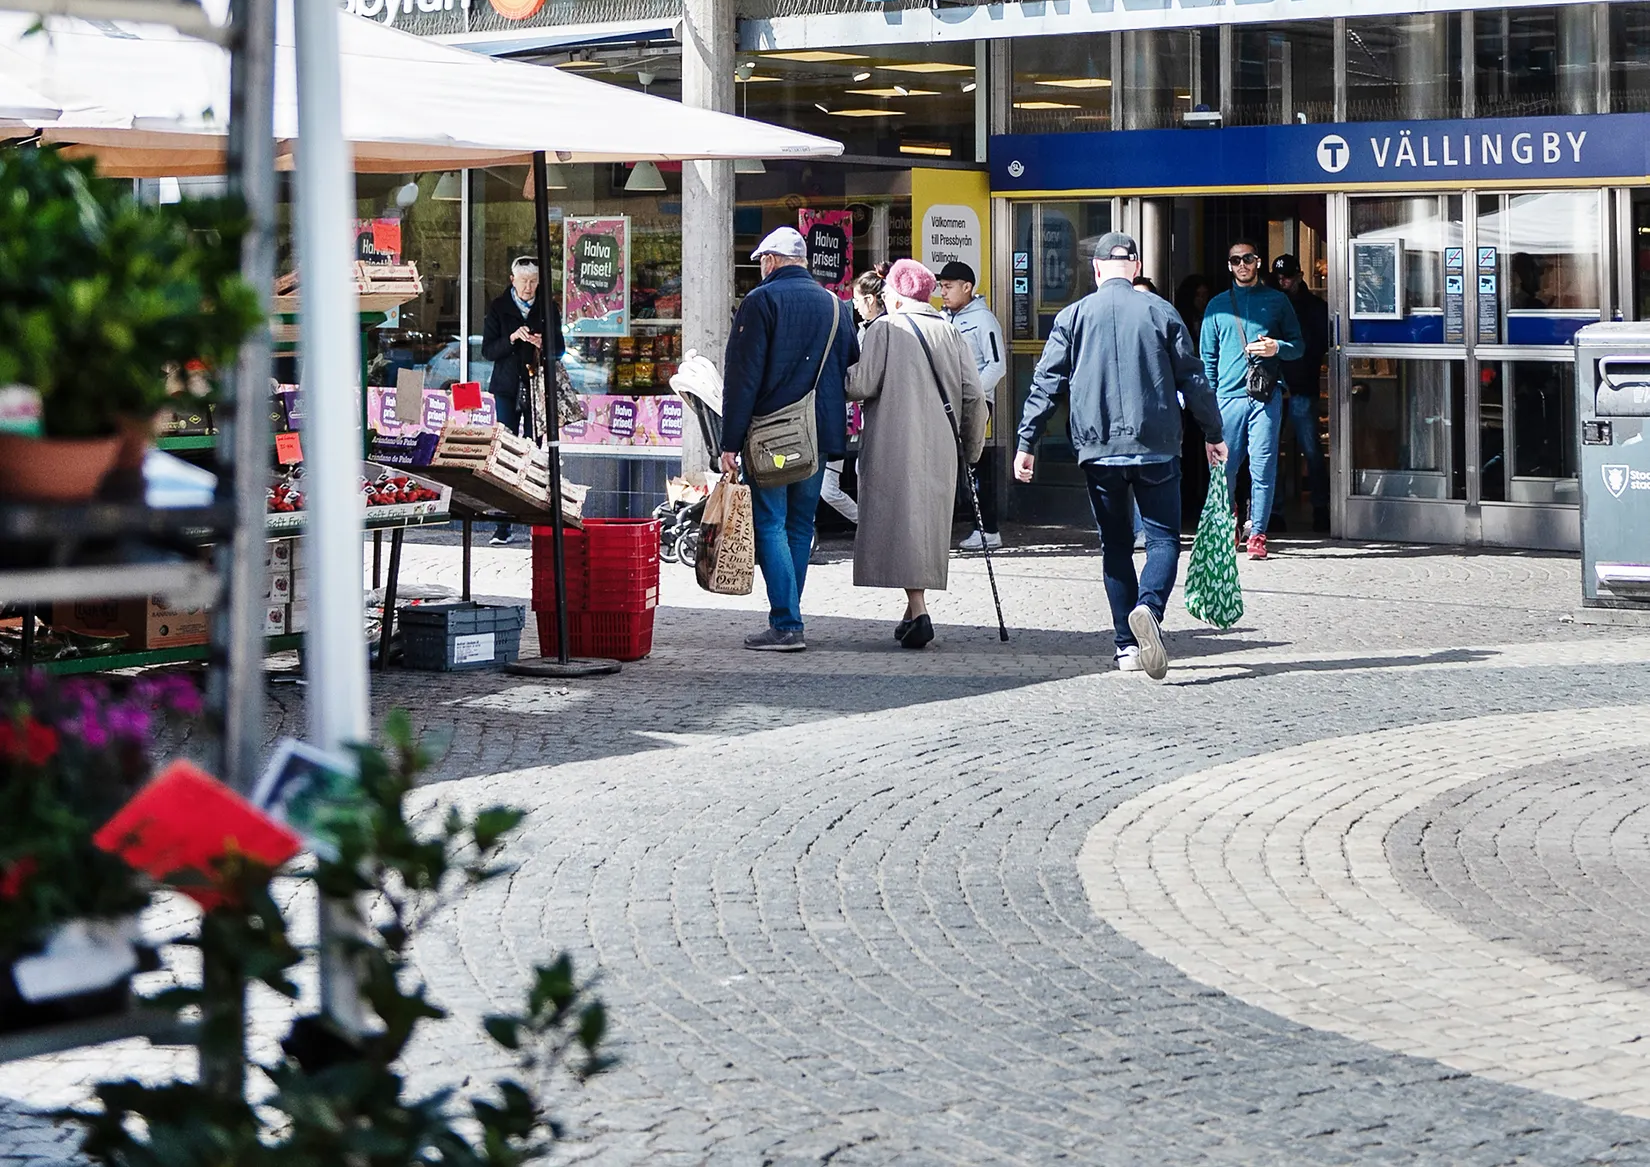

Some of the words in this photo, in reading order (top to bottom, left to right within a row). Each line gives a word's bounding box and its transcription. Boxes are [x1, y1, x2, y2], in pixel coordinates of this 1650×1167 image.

[1370, 129, 1587, 168] VÄLLINGBY
[931, 216, 966, 228] Välkommen
[815, 231, 839, 249] Halva
[931, 234, 939, 245] till
[940, 234, 972, 248] Pressbyrån
[584, 240, 611, 259] Halva
[812, 251, 840, 268] priset!
[580, 260, 612, 278] priset!
[429, 398, 447, 411] Halva
[615, 404, 634, 417] Halva
[663, 404, 682, 417] Halva
[612, 417, 634, 430] priset!
